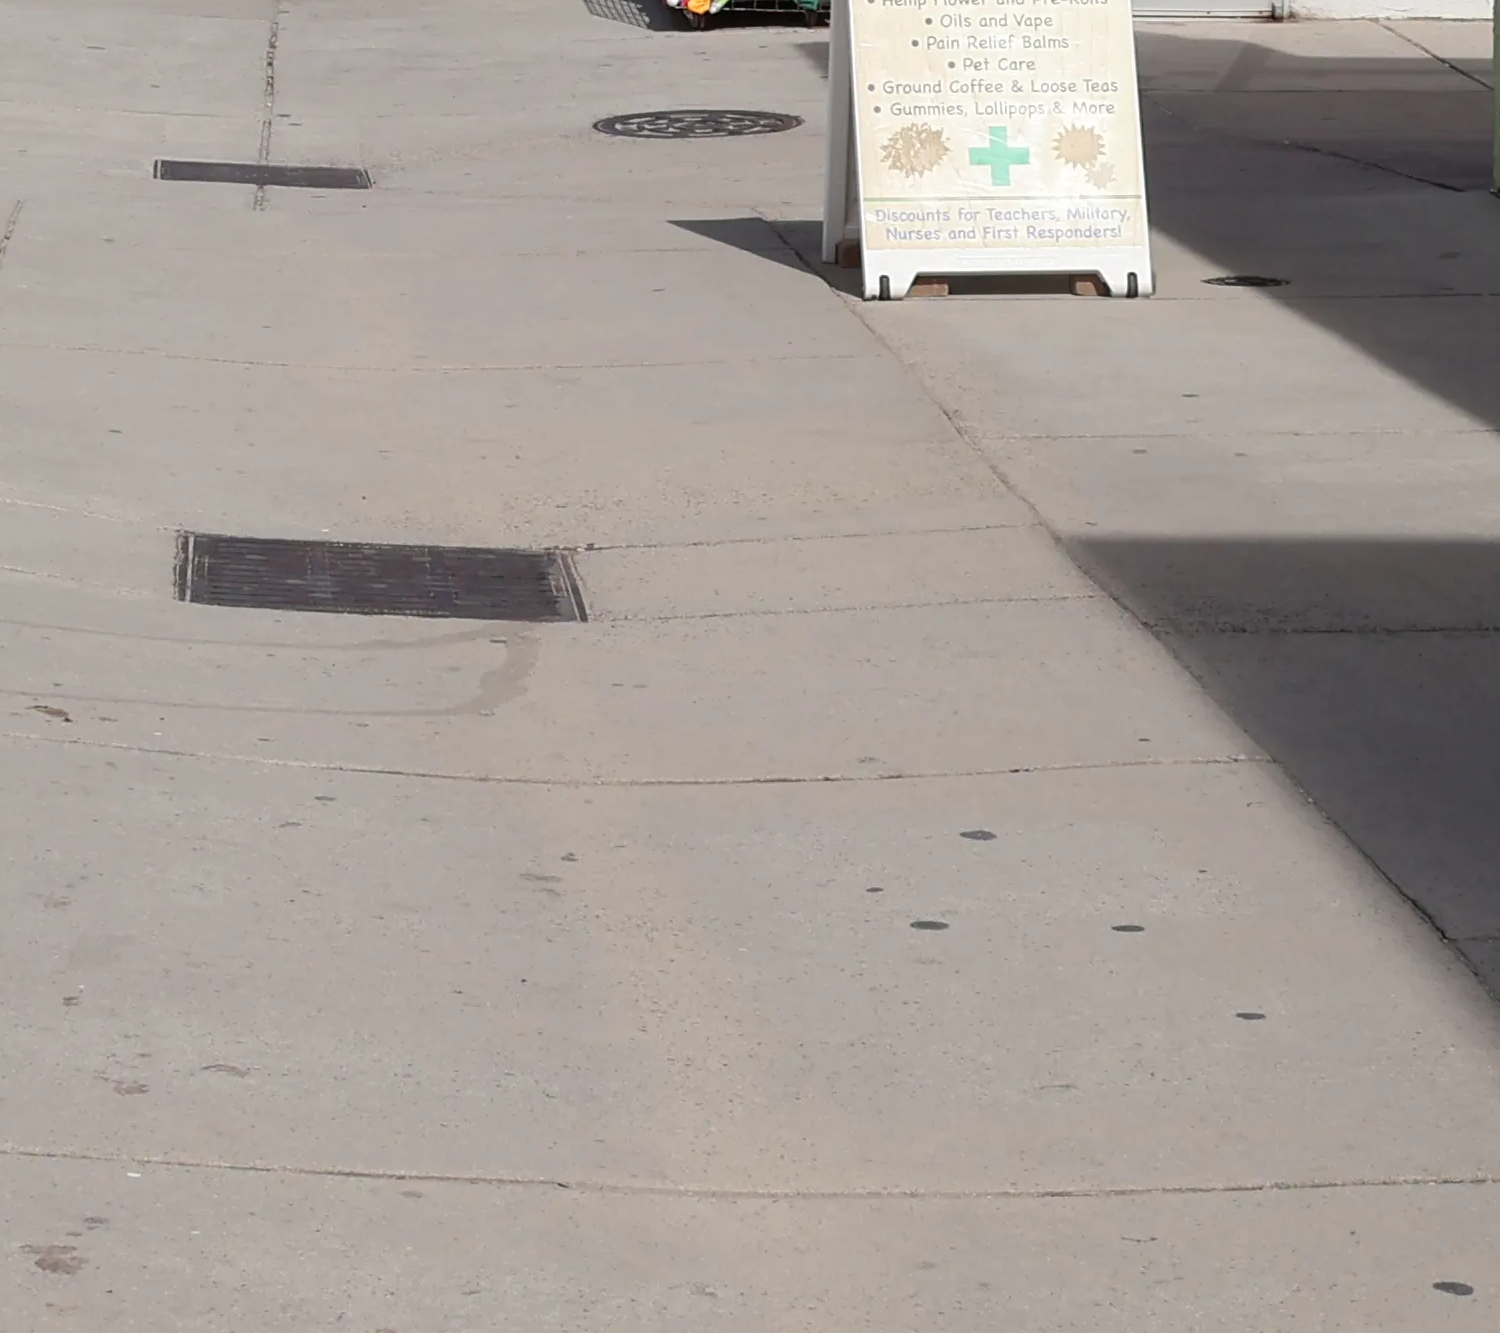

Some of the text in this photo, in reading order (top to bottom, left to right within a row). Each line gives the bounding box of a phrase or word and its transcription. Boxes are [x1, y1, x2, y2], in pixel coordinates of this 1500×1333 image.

[940, 13, 1054, 31] Oils and Vape
[926, 34, 1070, 50] Pain Relief Balms
[963, 57, 1036, 72] Pet Care
[882, 79, 1119, 94] Ground Coffee & Loose Teas
[890, 101, 1115, 119] Gummies, Lollipops & More
[874, 207, 1131, 224] Discounts for Teachers, Military,
[885, 225, 1122, 242] Nurses and First Responders!
